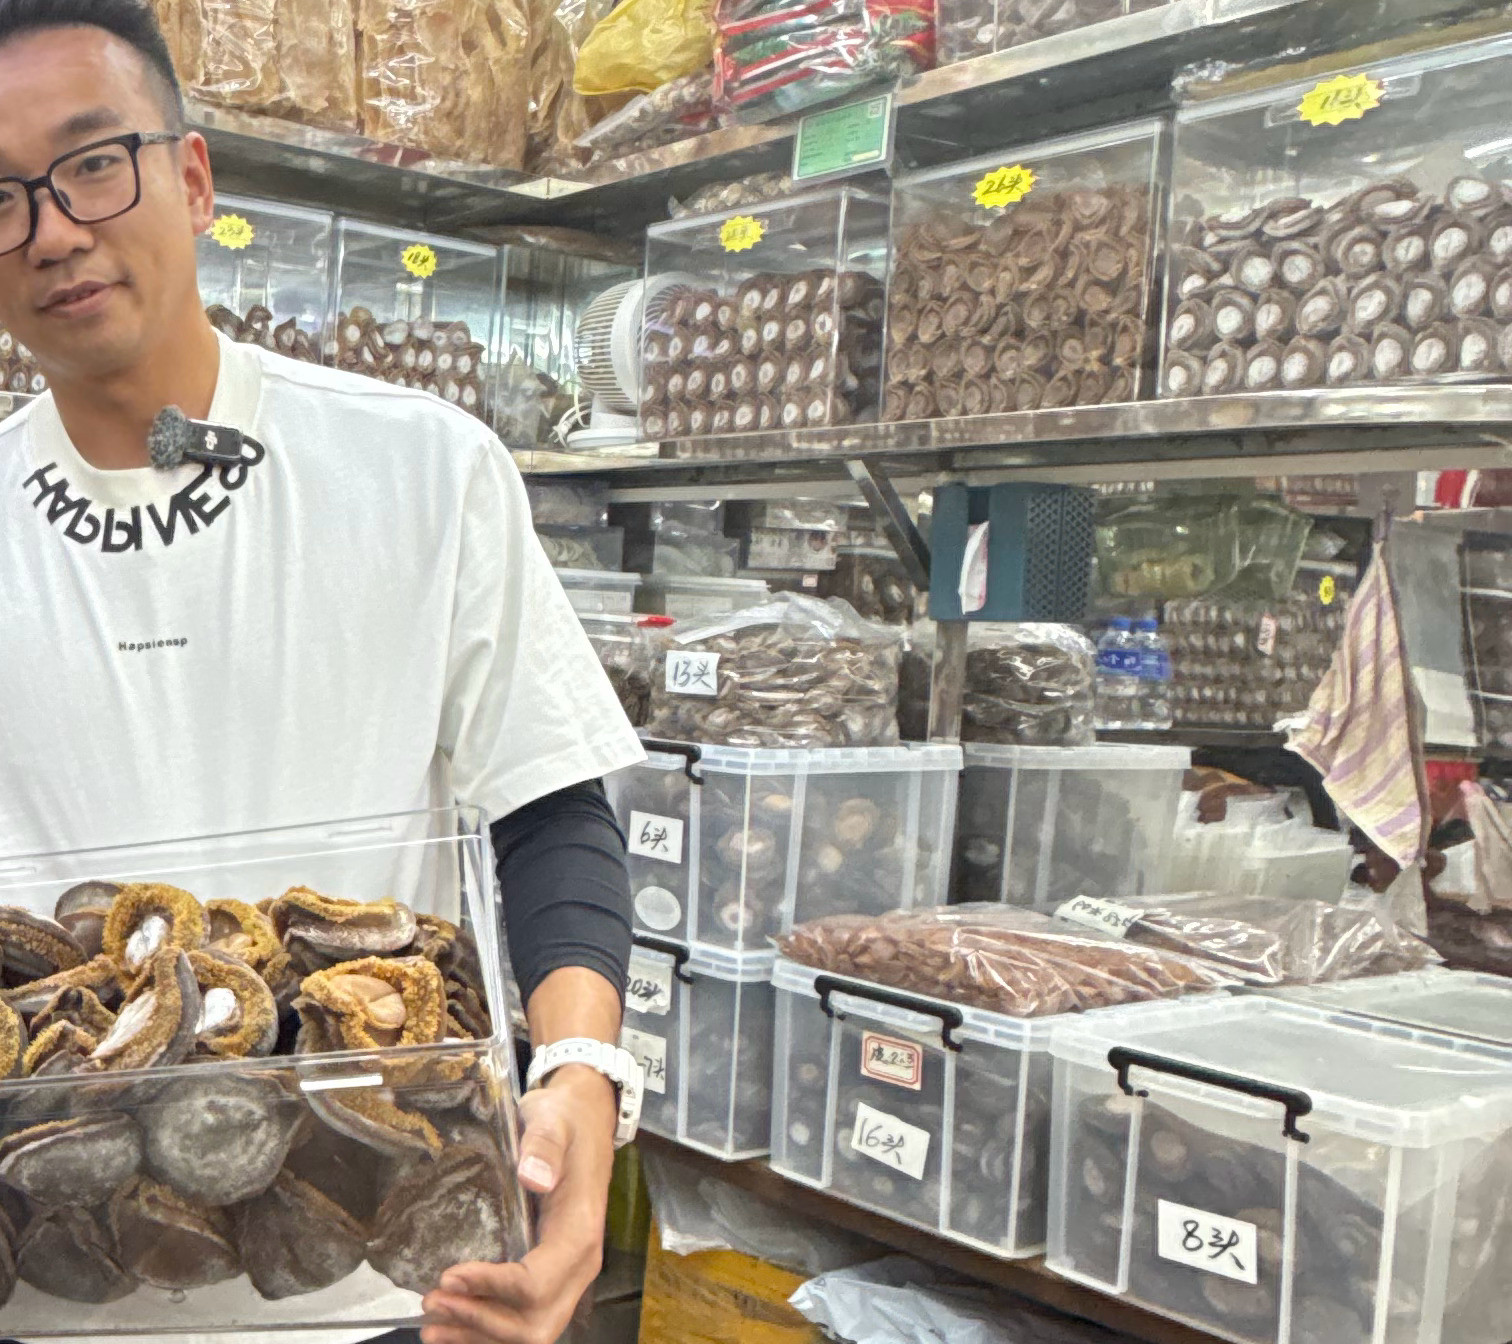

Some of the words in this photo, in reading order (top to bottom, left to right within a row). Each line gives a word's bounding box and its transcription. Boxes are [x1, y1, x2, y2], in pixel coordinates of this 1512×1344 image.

[672, 658, 715, 691] 13头
[640, 820, 669, 853] 6头
[858, 1118, 906, 1166] 16头
[1181, 1218, 1246, 1271] 8头
